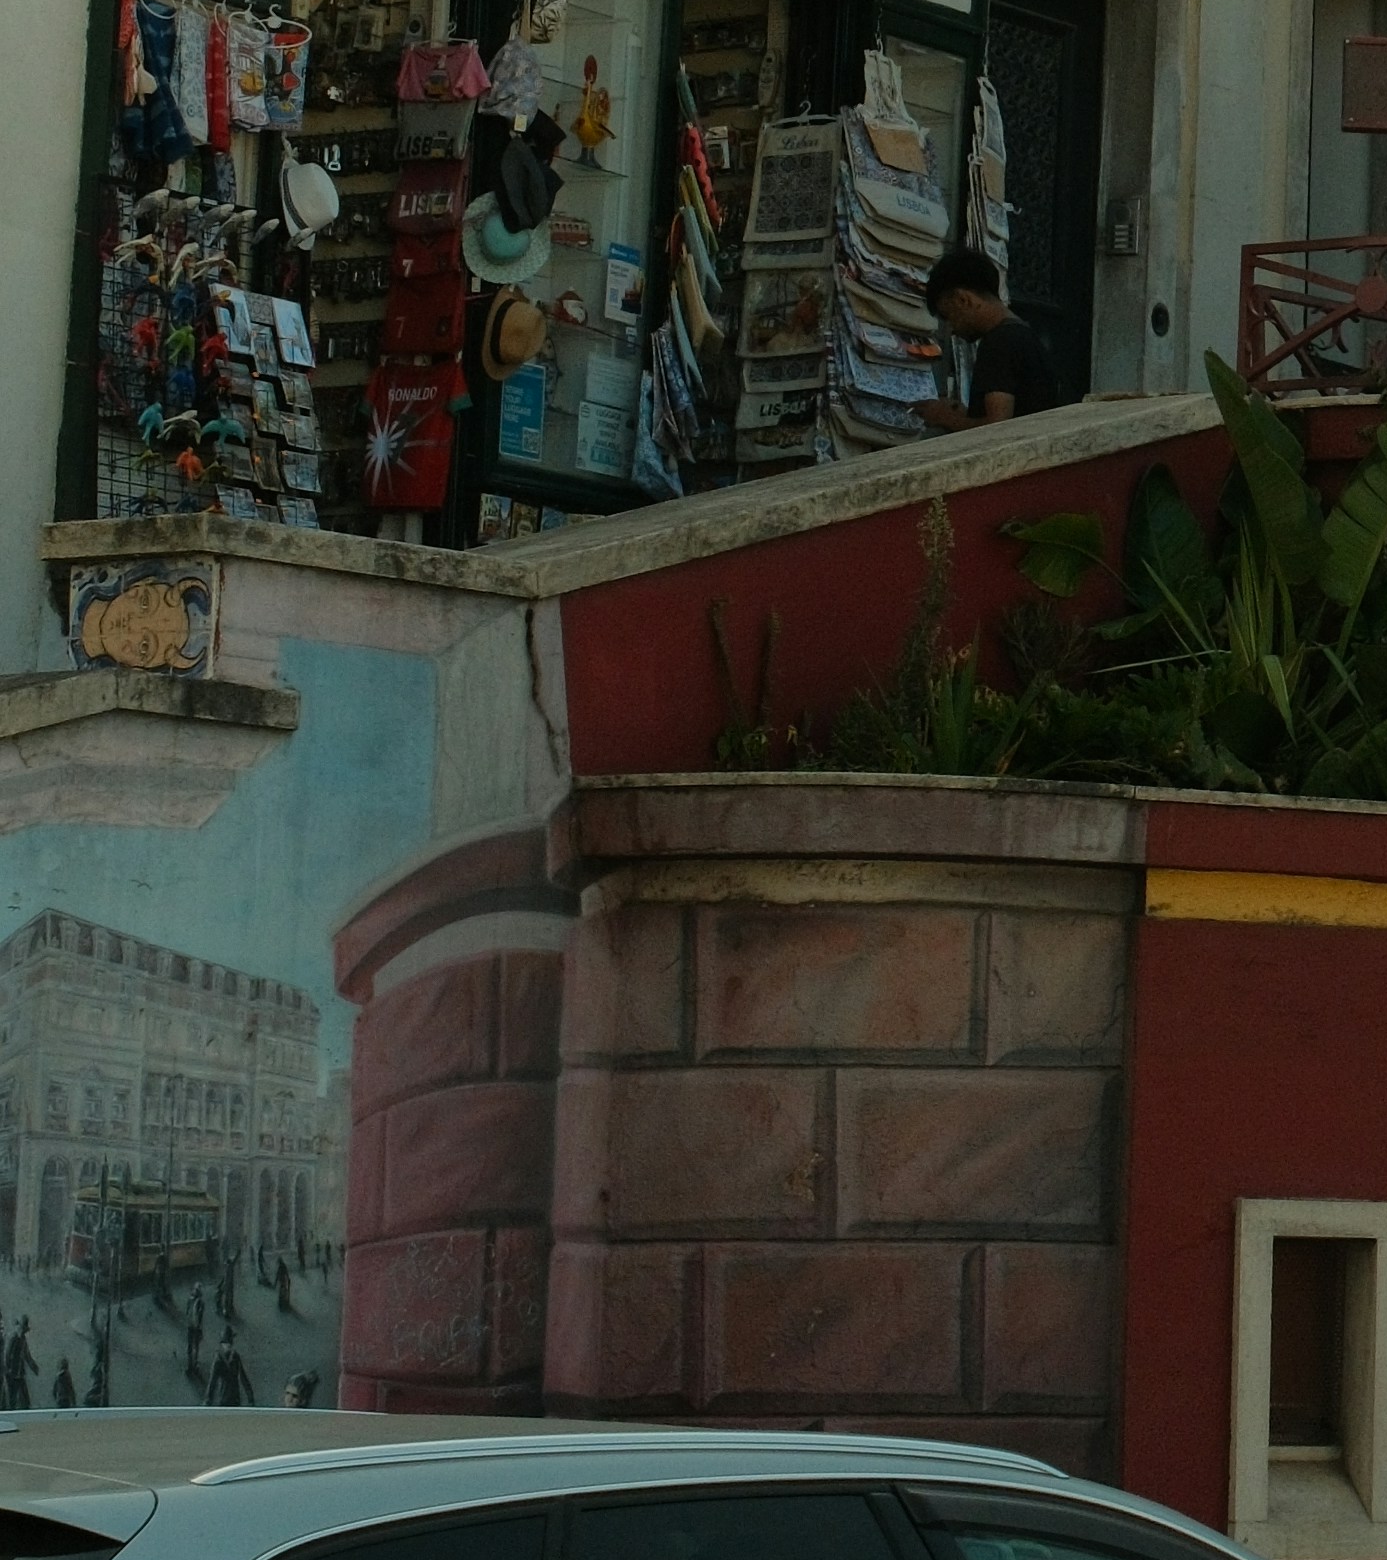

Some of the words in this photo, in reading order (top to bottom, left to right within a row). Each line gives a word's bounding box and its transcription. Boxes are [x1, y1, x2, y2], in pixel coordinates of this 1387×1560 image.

[402, 258, 414, 278] 7
[396, 317, 406, 339] 7
[388, 386, 438, 402] RONALDO
